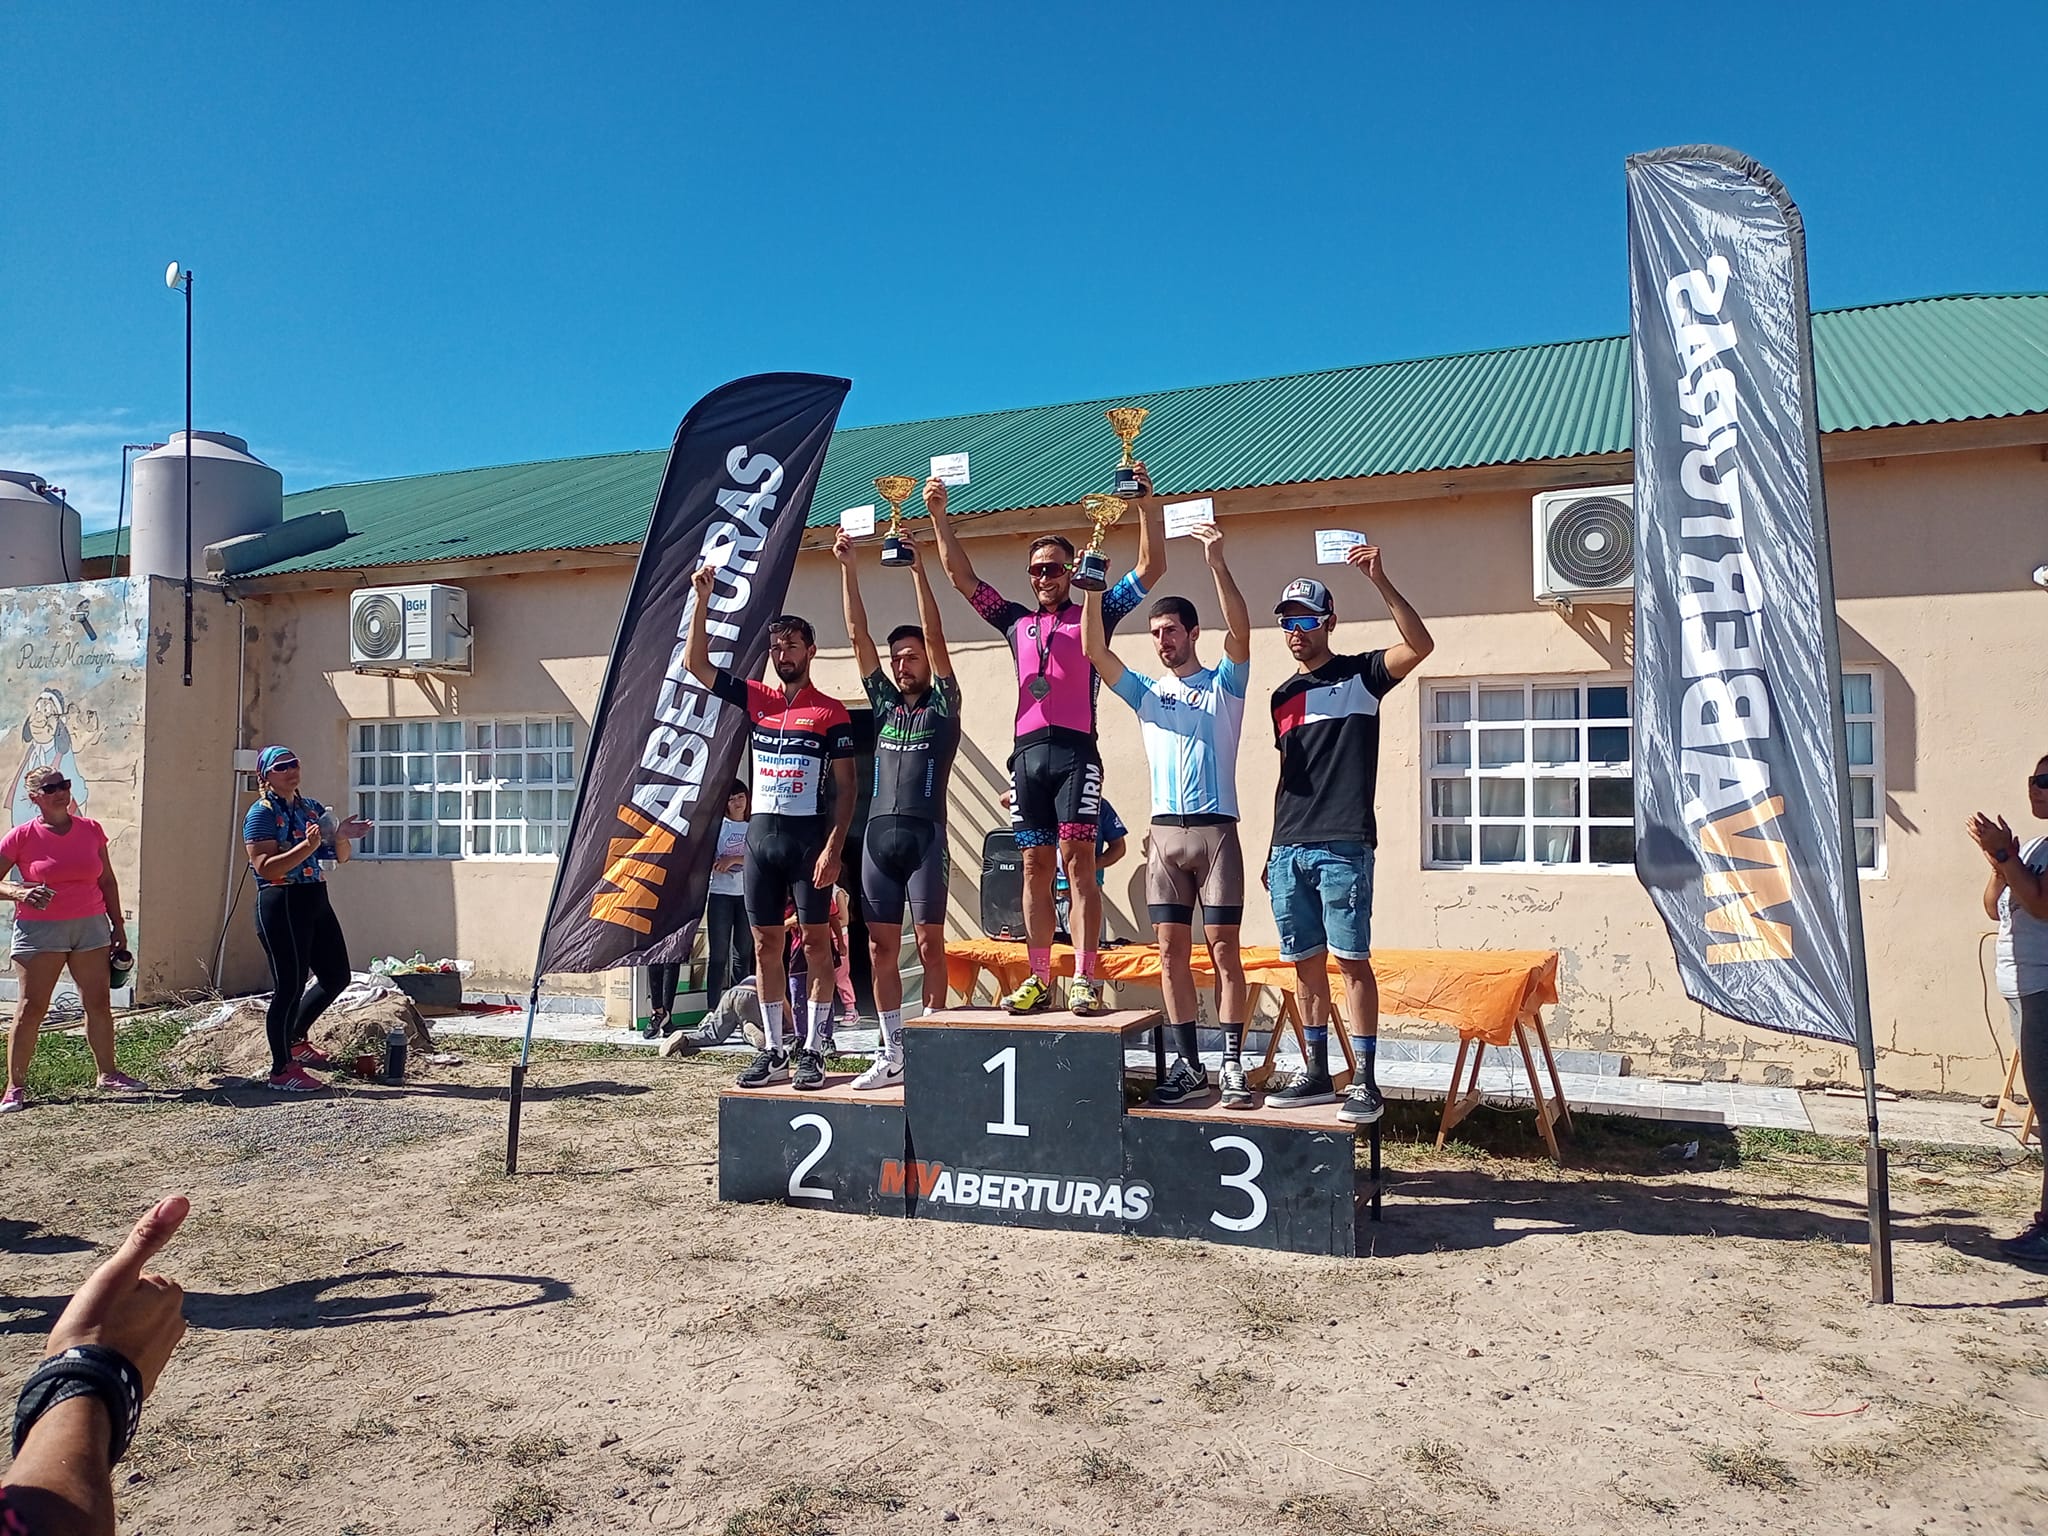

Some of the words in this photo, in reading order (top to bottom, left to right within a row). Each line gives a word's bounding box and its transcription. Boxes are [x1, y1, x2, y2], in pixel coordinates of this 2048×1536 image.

[406, 599, 427, 611] BGH
[16, 641, 60, 669] Puerto
[60, 641, 115, 674] Madryn
[757, 754, 810, 767] SHIMANO
[924, 758, 935, 798] SHIMANO
[792, 781, 804, 794] B
[1077, 763, 1101, 816] MRM
[982, 1047, 1030, 1137] 1
[788, 1113, 835, 1201] 2
[1209, 1135, 1268, 1232] 3
